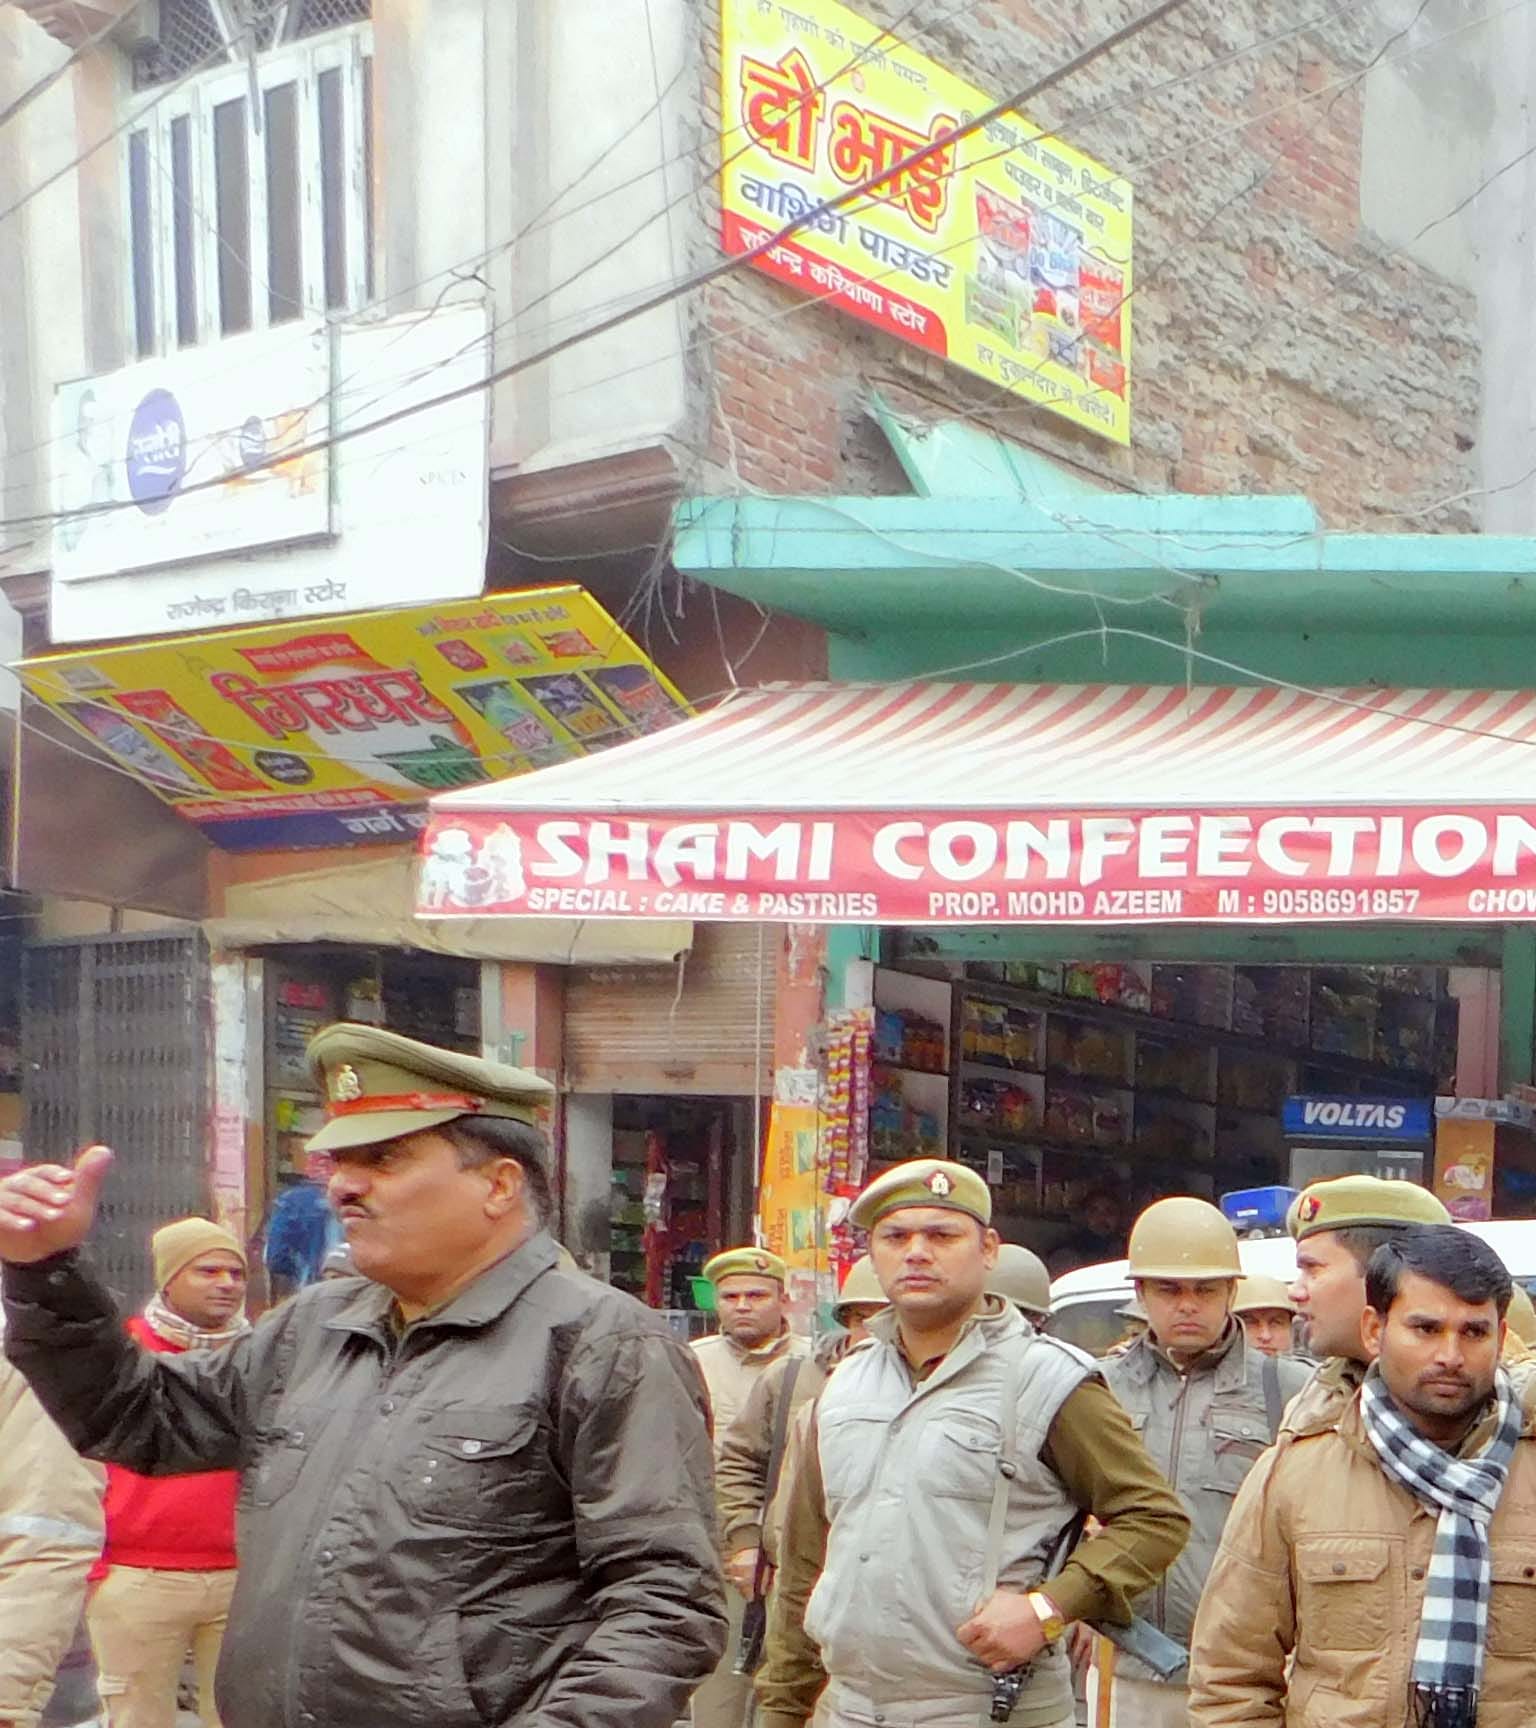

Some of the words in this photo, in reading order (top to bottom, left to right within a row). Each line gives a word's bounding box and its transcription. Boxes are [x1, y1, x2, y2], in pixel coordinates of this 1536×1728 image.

[858, 225, 953, 288] पाउडर
[889, 299, 927, 334] स्टोर
[304, 578, 346, 603] स्टोर
[527, 819, 836, 888] SHAMI
[527, 888, 633, 912] SPECIAL
[653, 890, 725, 914] CAKE
[732, 892, 750, 914] &
[757, 891, 878, 916] PASTRIES
[929, 891, 1001, 916] PROP.
[1008, 890, 1086, 916] MOHD
[1092, 889, 1182, 915] AZEEM
[1263, 889, 1420, 914] 9058691857
[1303, 1101, 1406, 1129] VOLTAS
